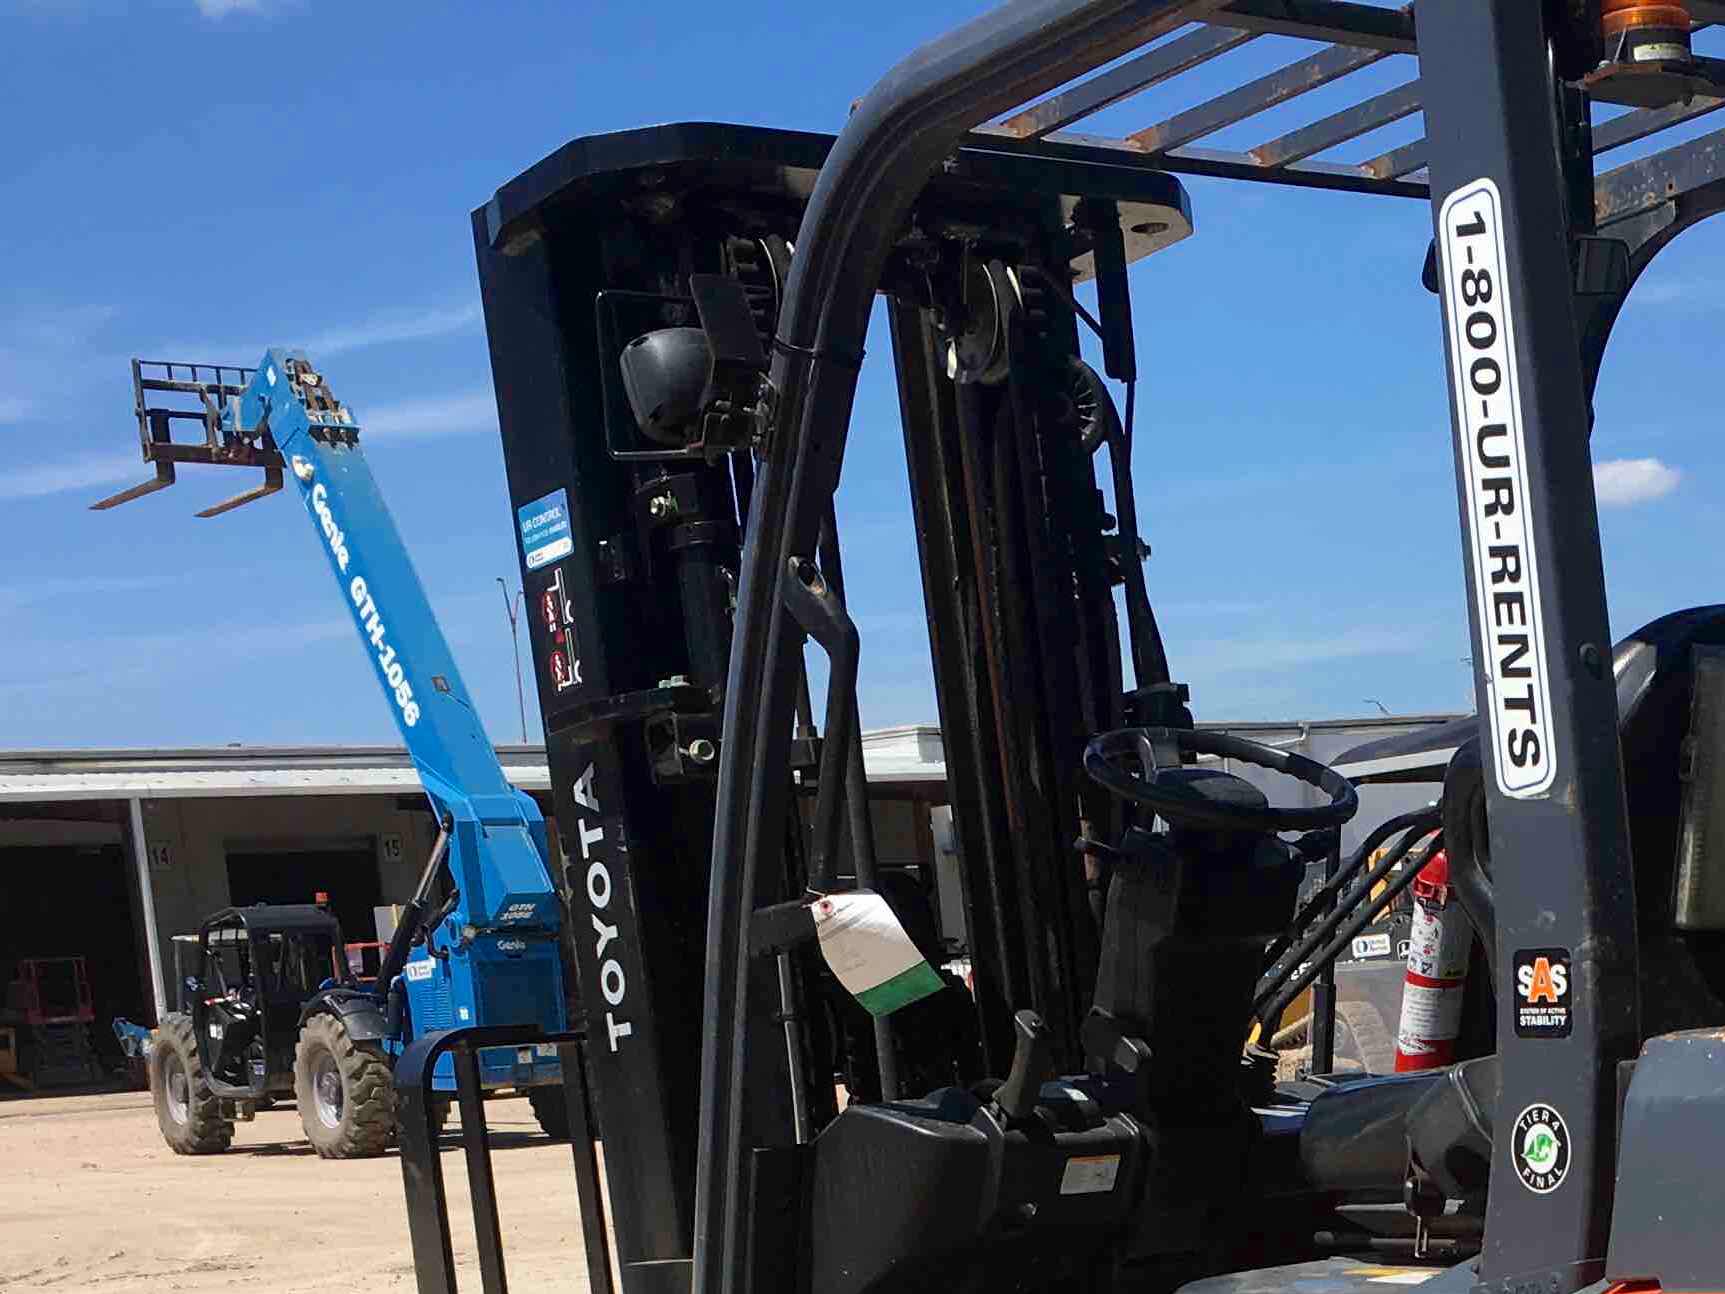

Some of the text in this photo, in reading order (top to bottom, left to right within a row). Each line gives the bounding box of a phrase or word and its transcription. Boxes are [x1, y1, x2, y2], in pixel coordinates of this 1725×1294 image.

[1455, 210, 1541, 769] 1-800-UR-RENTS
[312, 483, 420, 728] Genie GTH-1056
[385, 840, 400, 858] 15
[574, 761, 634, 1054] TOYOTA
[1517, 957, 1568, 1003] SAS
[1519, 1015, 1567, 1026] STABILITY
[1519, 1109, 1550, 1131] TIER
[1522, 1167, 1563, 1188] FINAL
